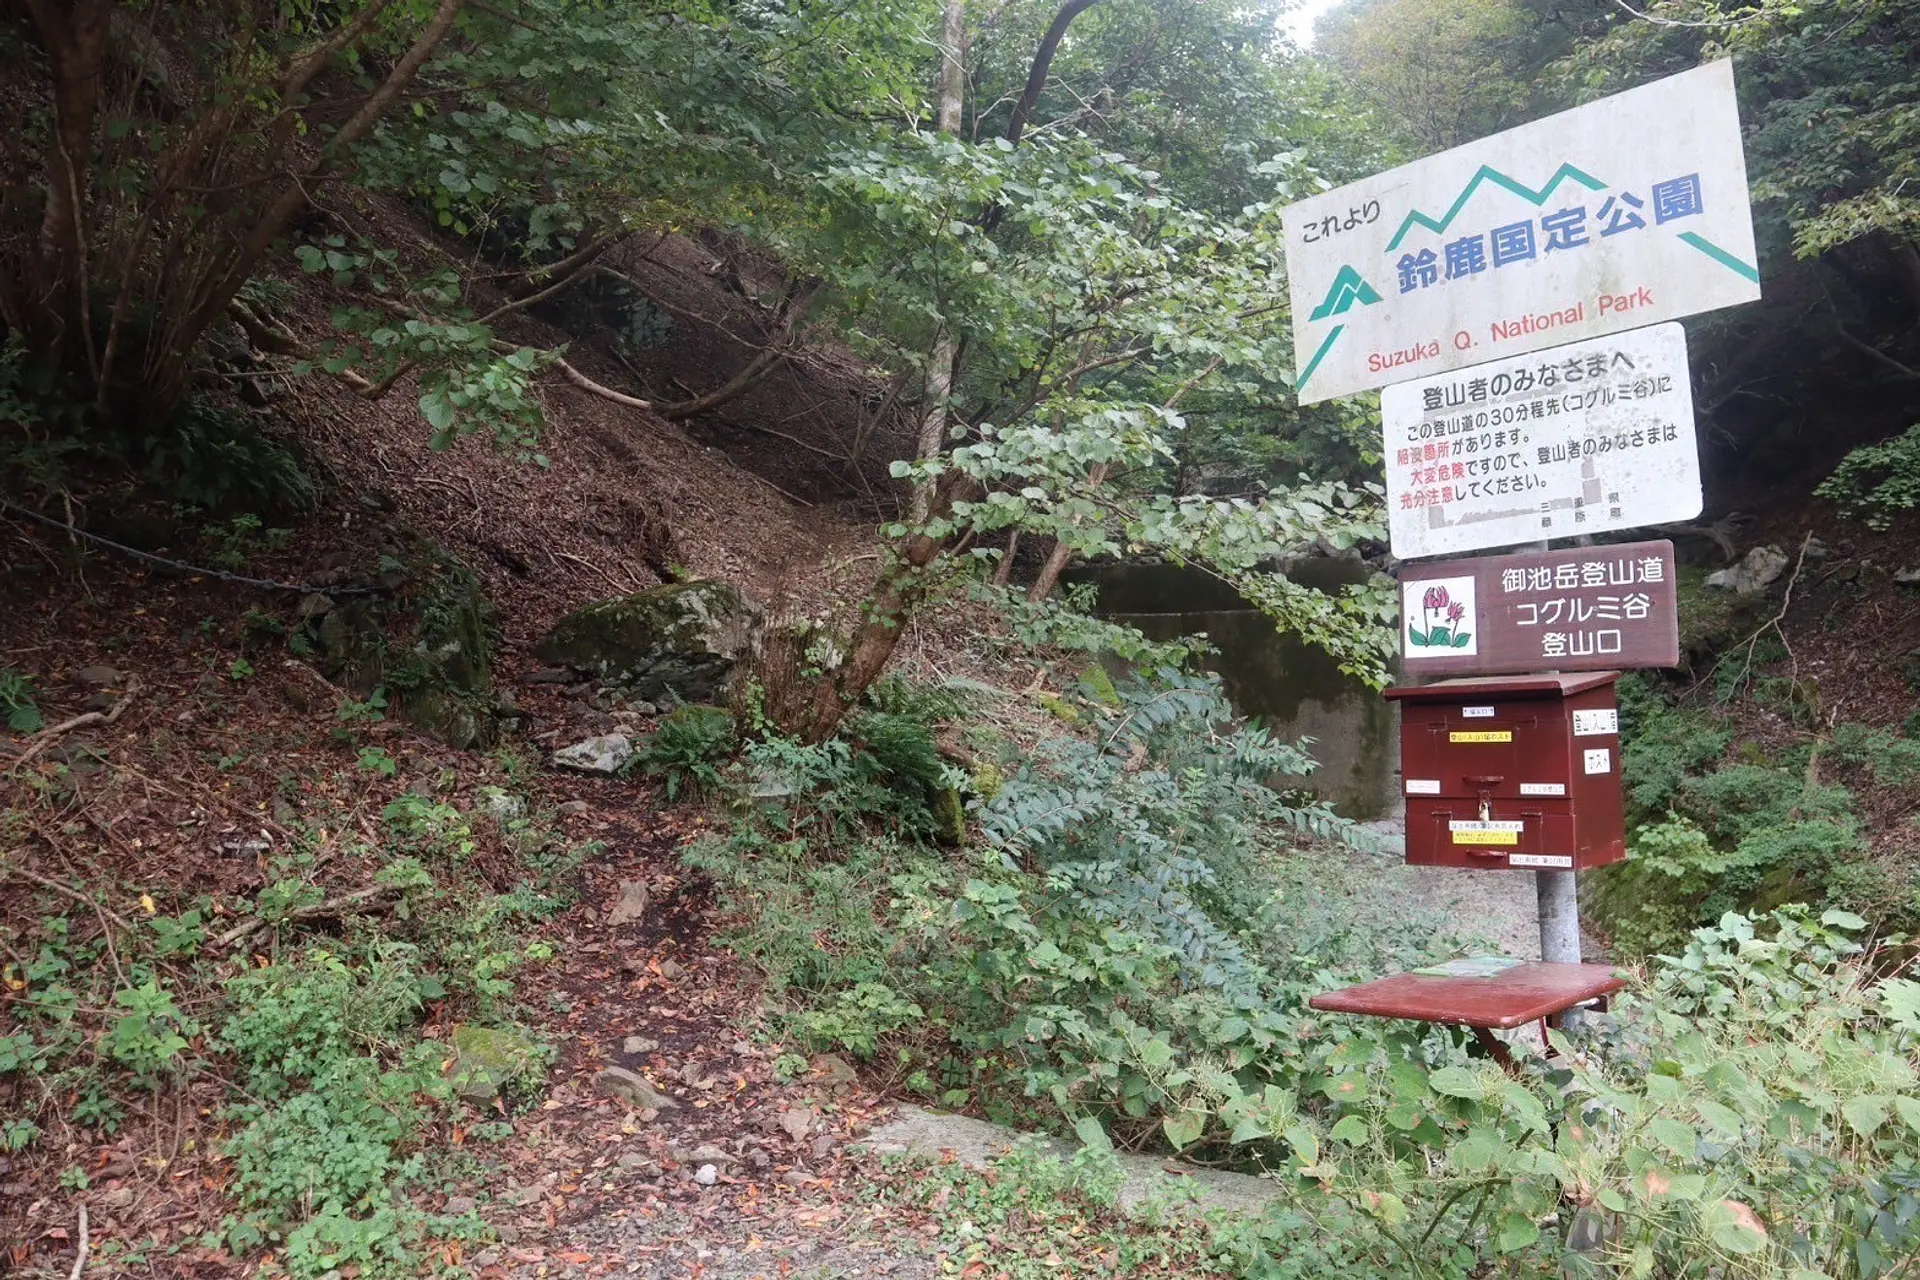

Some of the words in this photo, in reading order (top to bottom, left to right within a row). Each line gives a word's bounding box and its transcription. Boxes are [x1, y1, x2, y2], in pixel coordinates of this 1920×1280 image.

[1302, 199, 1382, 243] これより
[1396, 172, 1703, 294] 鈴鹿国定公園
[1368, 339, 1440, 373] Suzuka
[1453, 330, 1478, 351] Q.
[1491, 301, 1584, 343] National
[1599, 286, 1654, 317] Park
[1423, 351, 1636, 412] 登山者のみなさまへ
[1502, 556, 1664, 593] 御池岳登山道
[1516, 593, 1651, 626] コグルミ谷
[1541, 629, 1621, 657] 登山口
